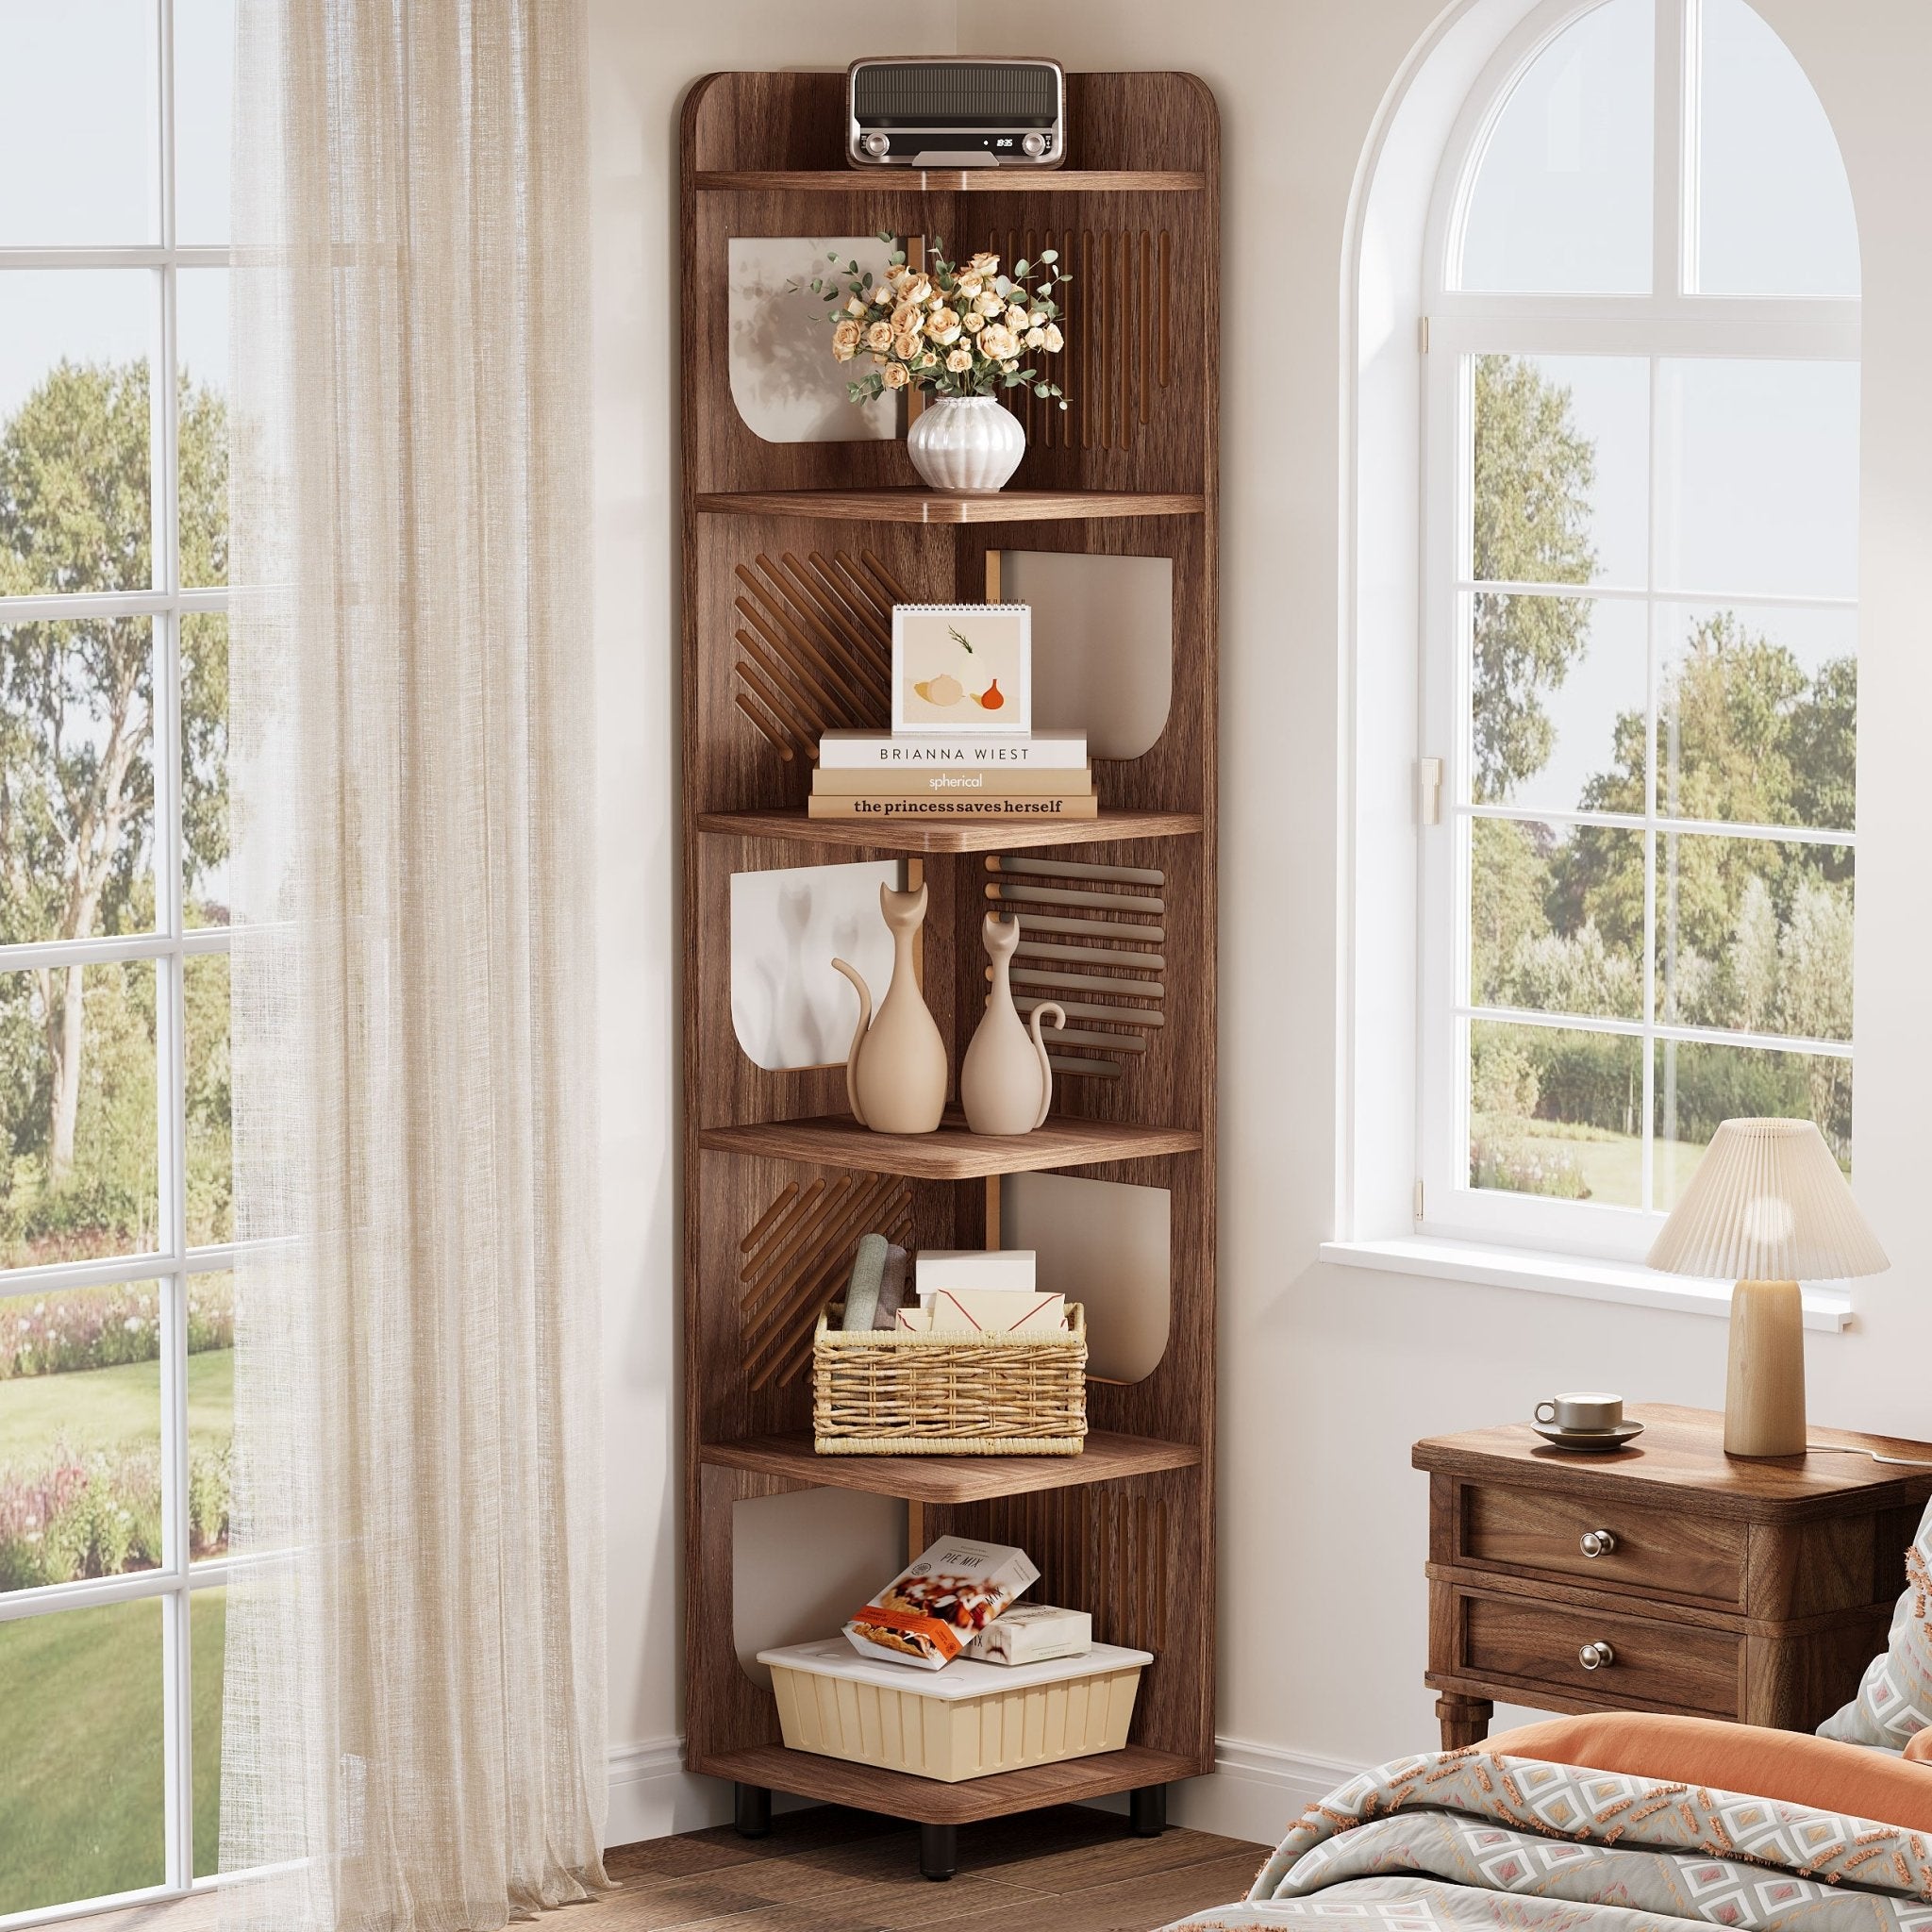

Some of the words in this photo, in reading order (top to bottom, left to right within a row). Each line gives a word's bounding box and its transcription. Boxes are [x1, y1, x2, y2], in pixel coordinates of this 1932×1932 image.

[880, 748, 964, 760] BRIANNA
[974, 748, 1029, 760] WIEST
[929, 774, 982, 791] spherical
[855, 800, 882, 813] the
[884, 800, 955, 815] princess
[956, 804, 1002, 813] saves
[1003, 800, 1063, 813] herself
[941, 1553, 960, 1565] PIE
[960, 1557, 983, 1569] MIX
[985, 1586, 1004, 1607] MIX
